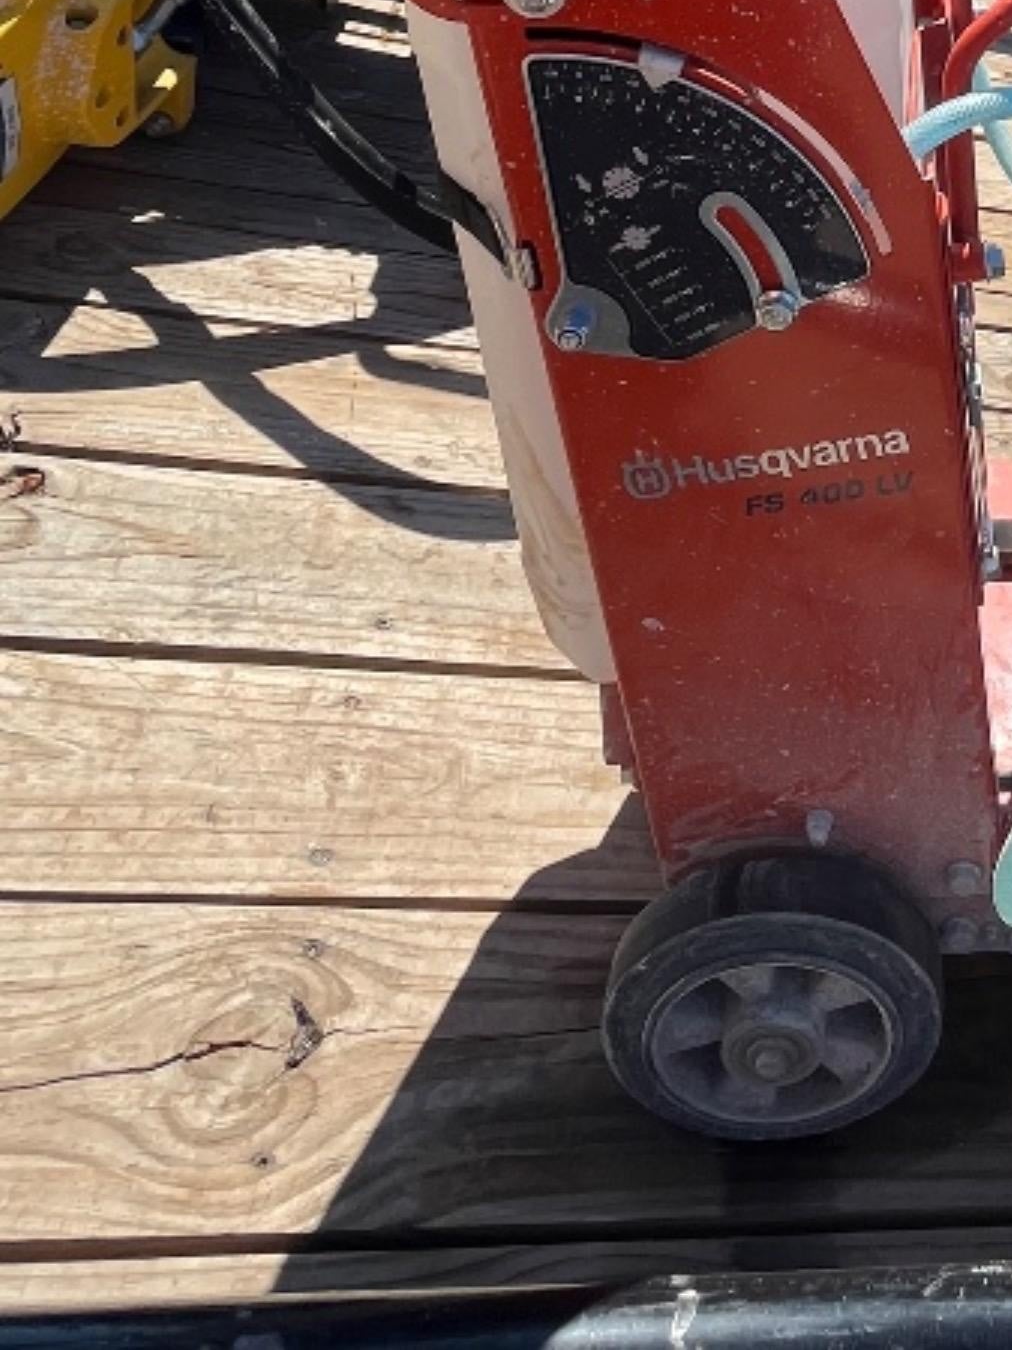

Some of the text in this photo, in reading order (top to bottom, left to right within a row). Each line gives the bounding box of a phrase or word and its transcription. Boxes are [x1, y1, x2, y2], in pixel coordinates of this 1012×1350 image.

[672, 428, 911, 488] Husqvarna
[745, 470, 914, 517] FS 400 LV
